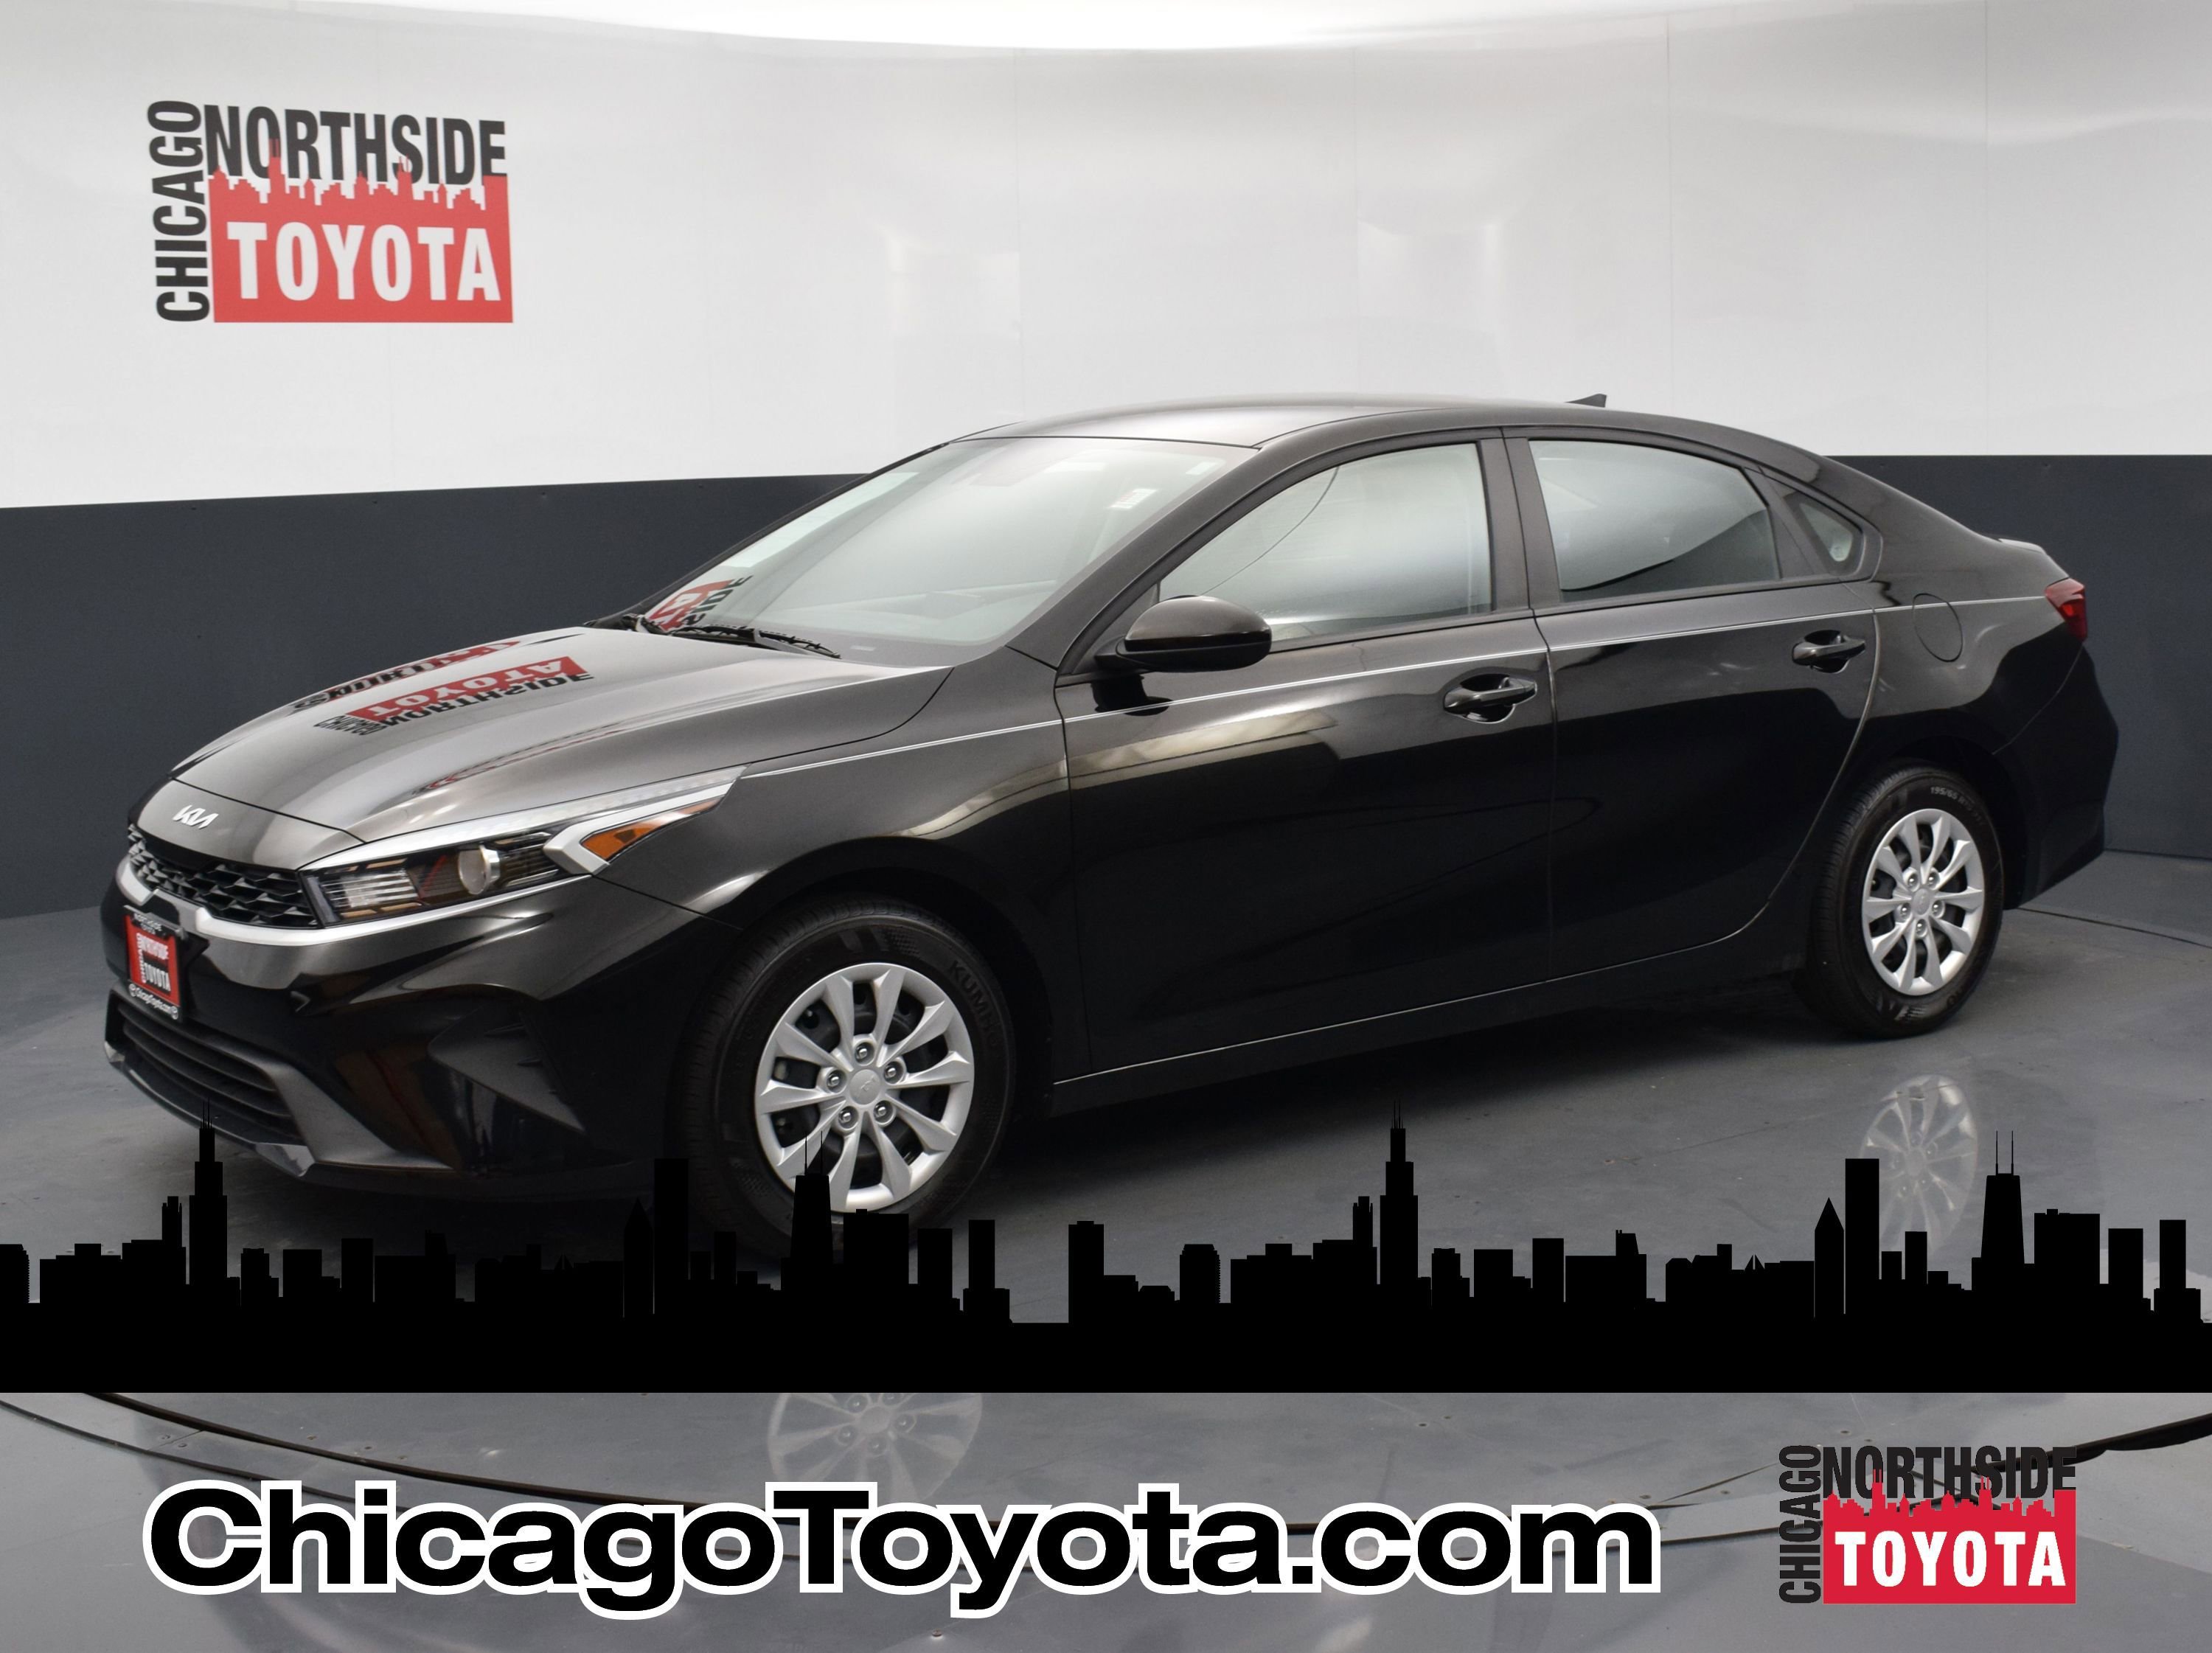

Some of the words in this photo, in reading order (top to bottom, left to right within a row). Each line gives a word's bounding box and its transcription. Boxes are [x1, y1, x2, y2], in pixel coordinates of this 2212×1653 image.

[204, 103, 507, 186] NORTHSIDE
[147, 100, 210, 322] CHICAGO
[226, 221, 501, 302] TOYOTA
